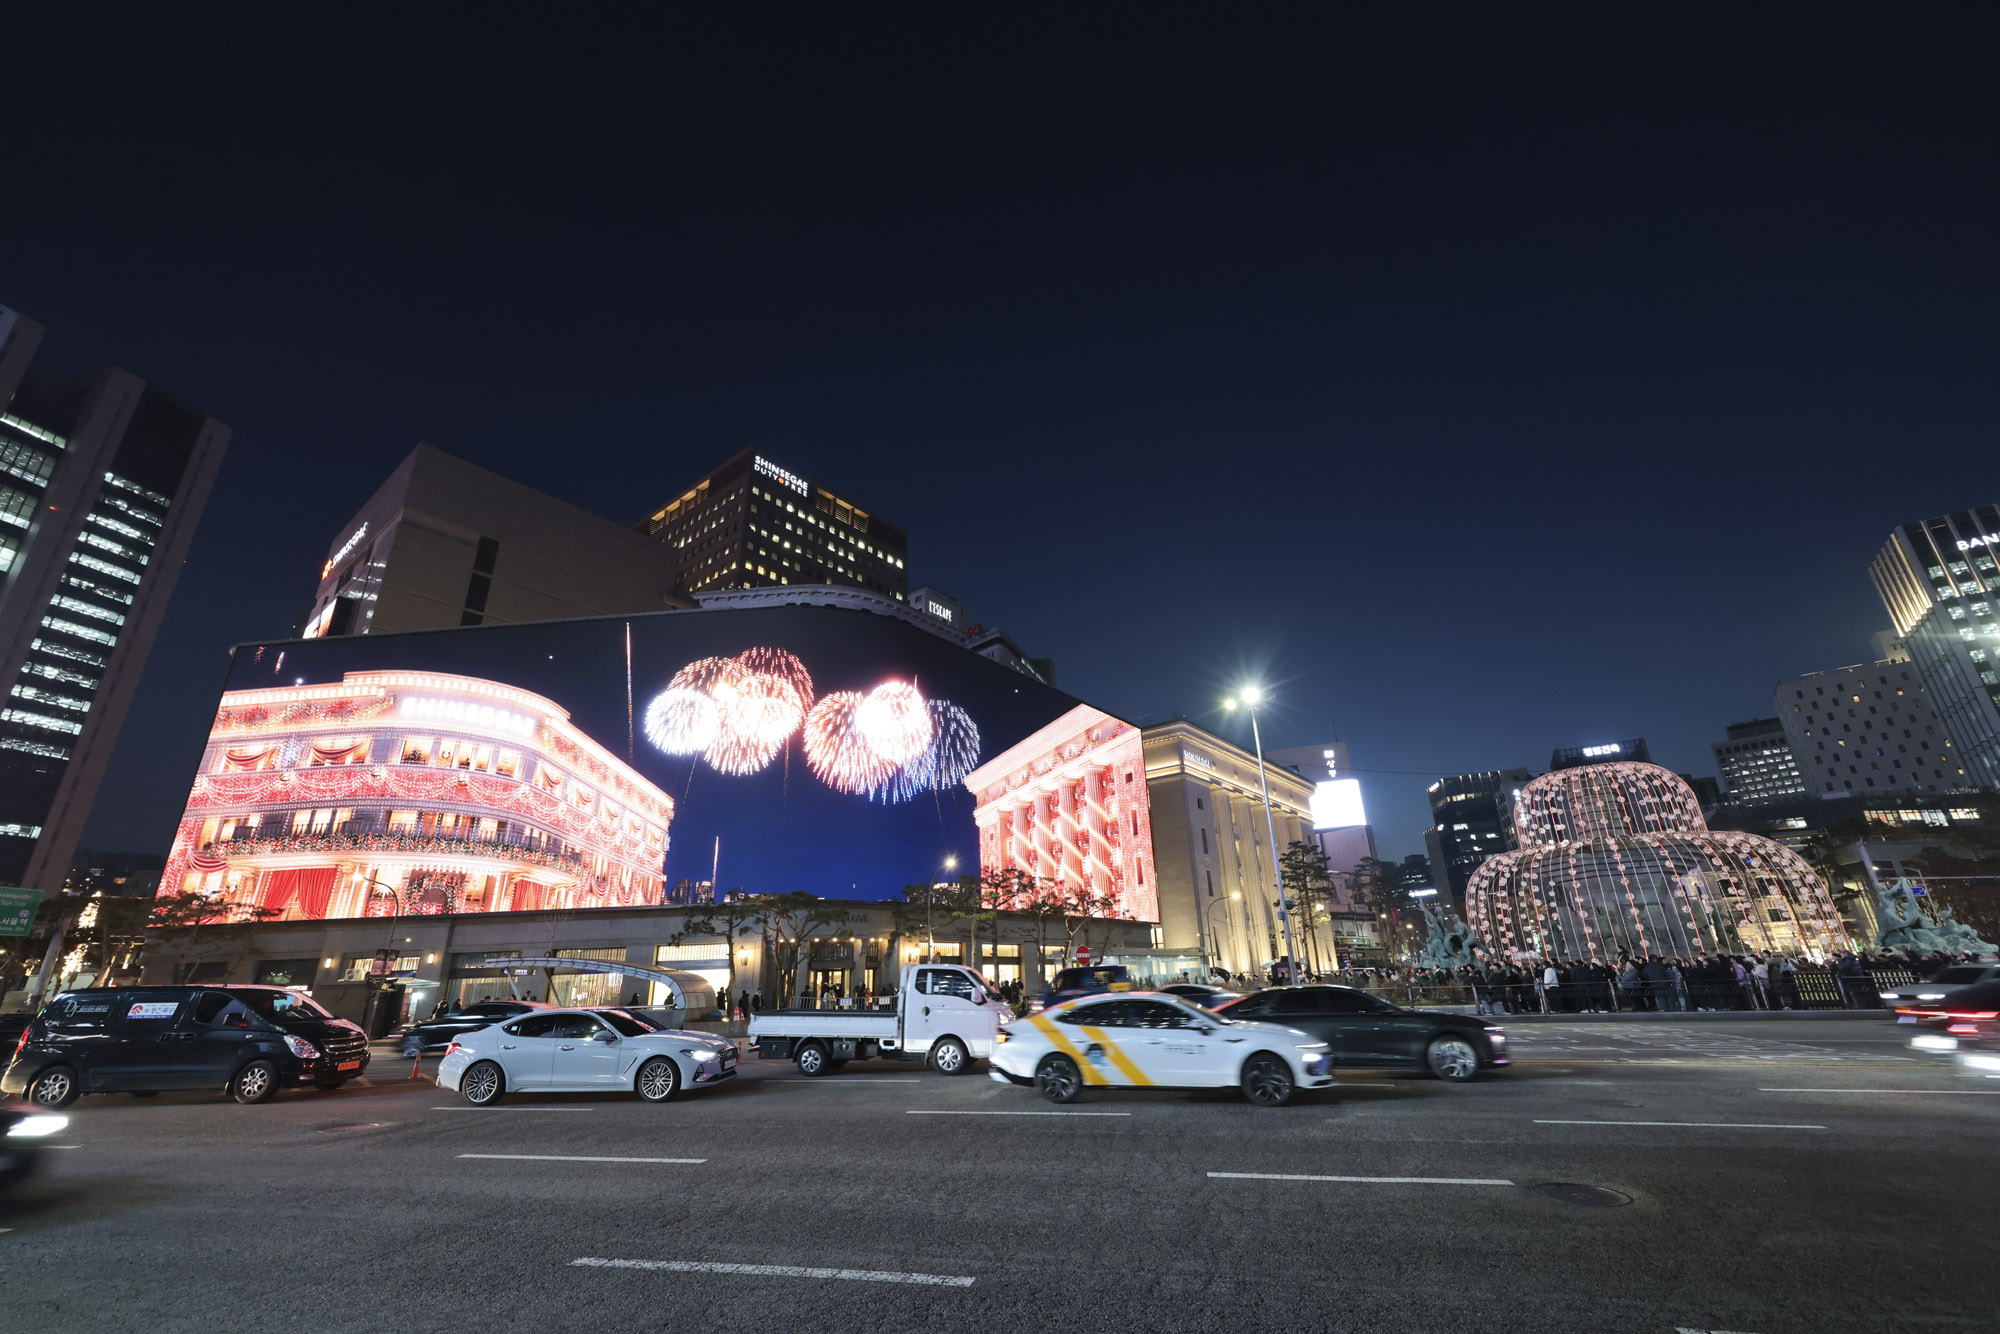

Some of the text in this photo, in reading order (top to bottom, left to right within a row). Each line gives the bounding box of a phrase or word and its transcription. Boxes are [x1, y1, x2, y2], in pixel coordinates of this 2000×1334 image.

[754, 455, 808, 491] SHINSEGAE
[754, 463, 808, 498] DUTY FREE
[1956, 531, 2000, 551] BAN
[0, 917, 29, 927] 서울역
